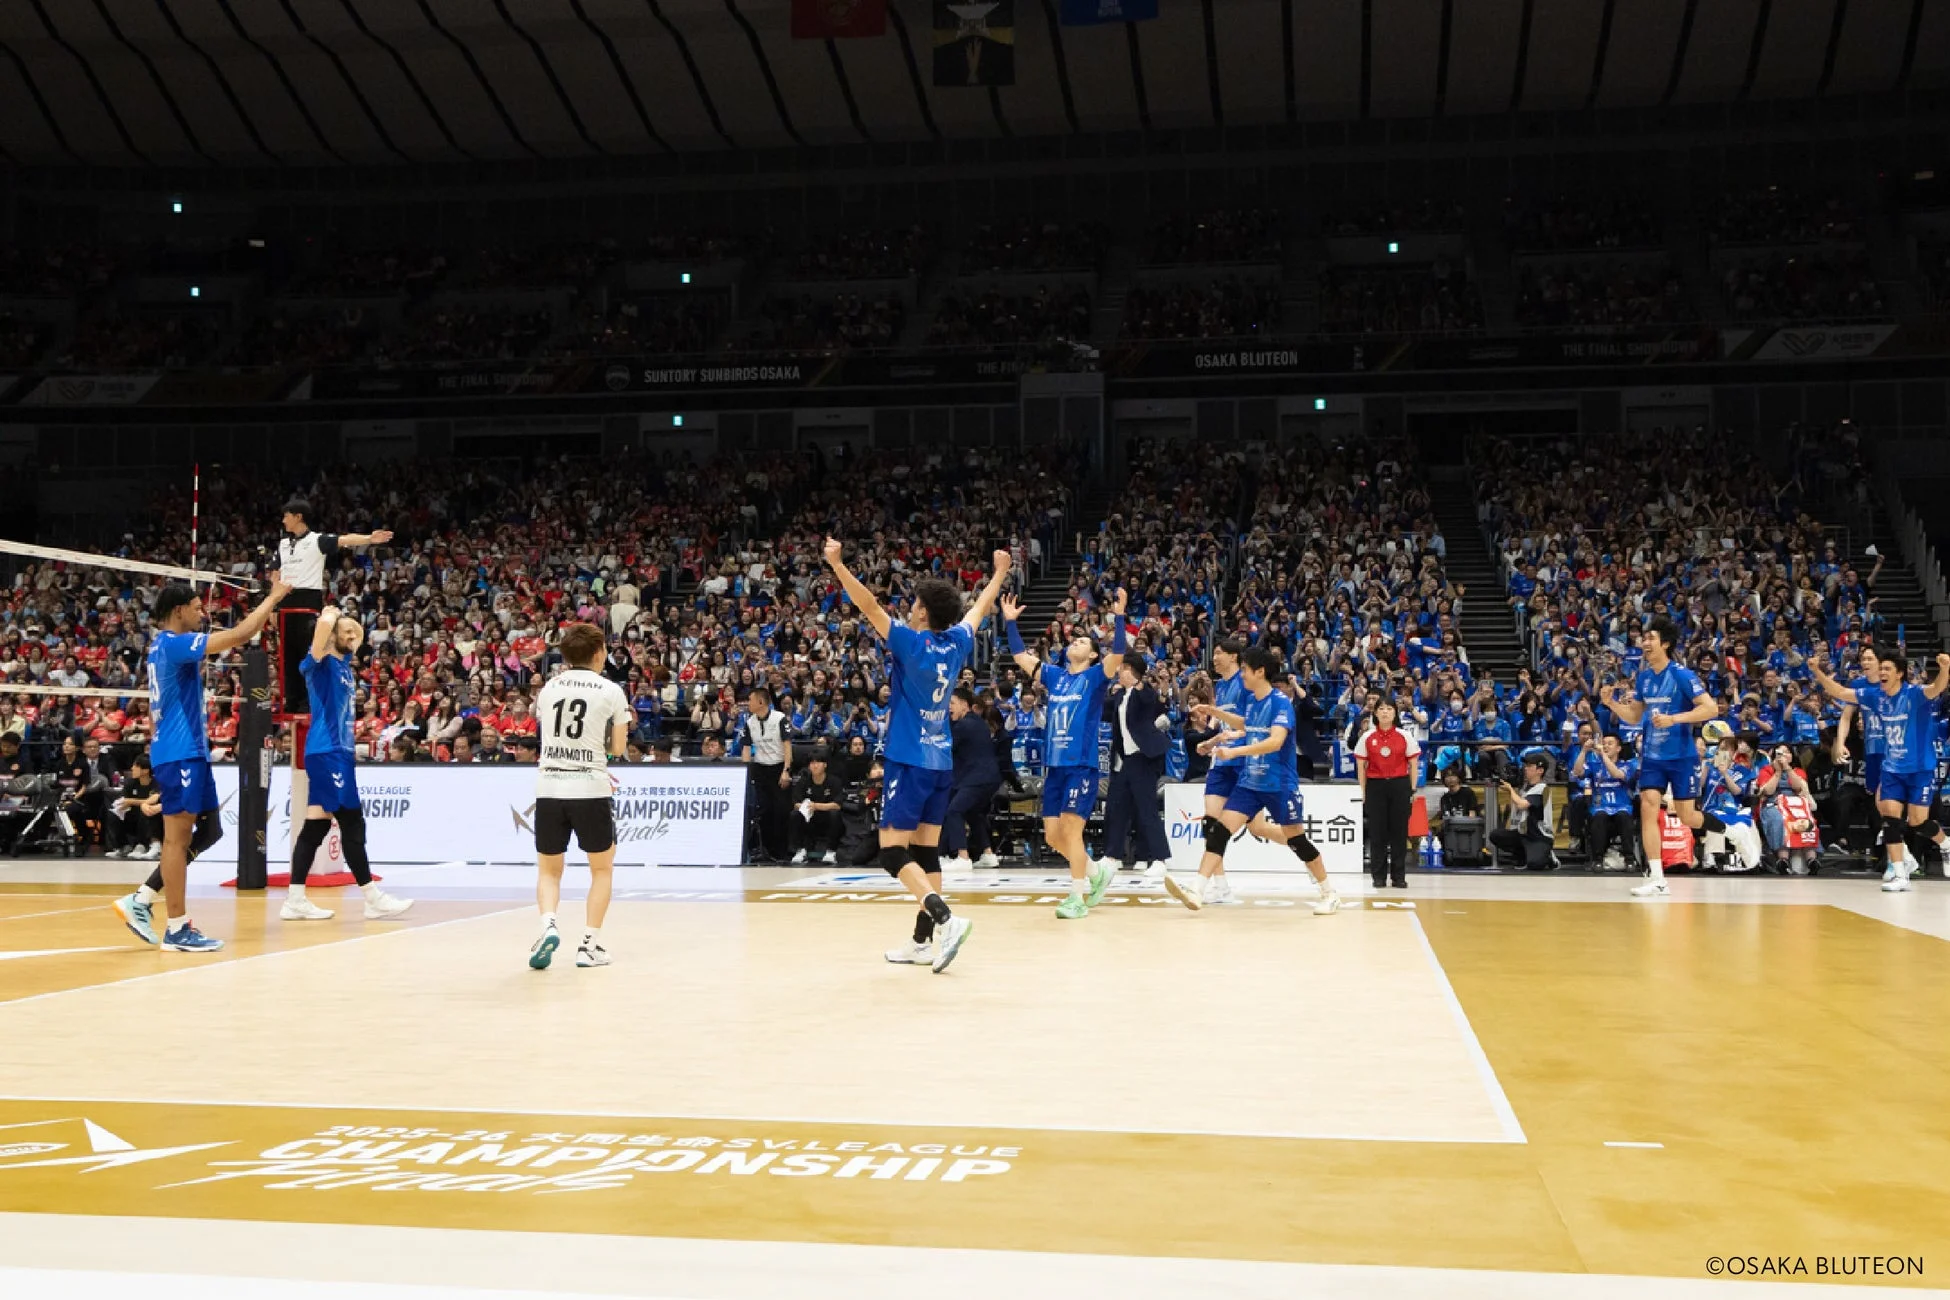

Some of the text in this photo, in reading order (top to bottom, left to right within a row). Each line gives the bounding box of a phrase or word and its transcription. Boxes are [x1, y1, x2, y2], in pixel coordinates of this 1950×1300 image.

[1562, 343, 1583, 356] THE
[1589, 342, 1622, 356] FINAL
[976, 361, 998, 374] THE
[1195, 351, 1298, 368] OSAKA BLUTEON
[437, 376, 457, 388] THE
[644, 366, 800, 383] SUNTORY SUNBIRDS OSAKA
[932, 663, 949, 703] 5
[552, 698, 587, 739] 13
[1053, 706, 1068, 730] 11
[1886, 725, 1905, 745] 22
[612, 799, 730, 821] HAMPIONSHIP
[314, 1125, 515, 1143] 2025-26
[258, 1138, 1012, 1183] CHAMPIONSHIP
[152, 1157, 634, 1195] Finals
